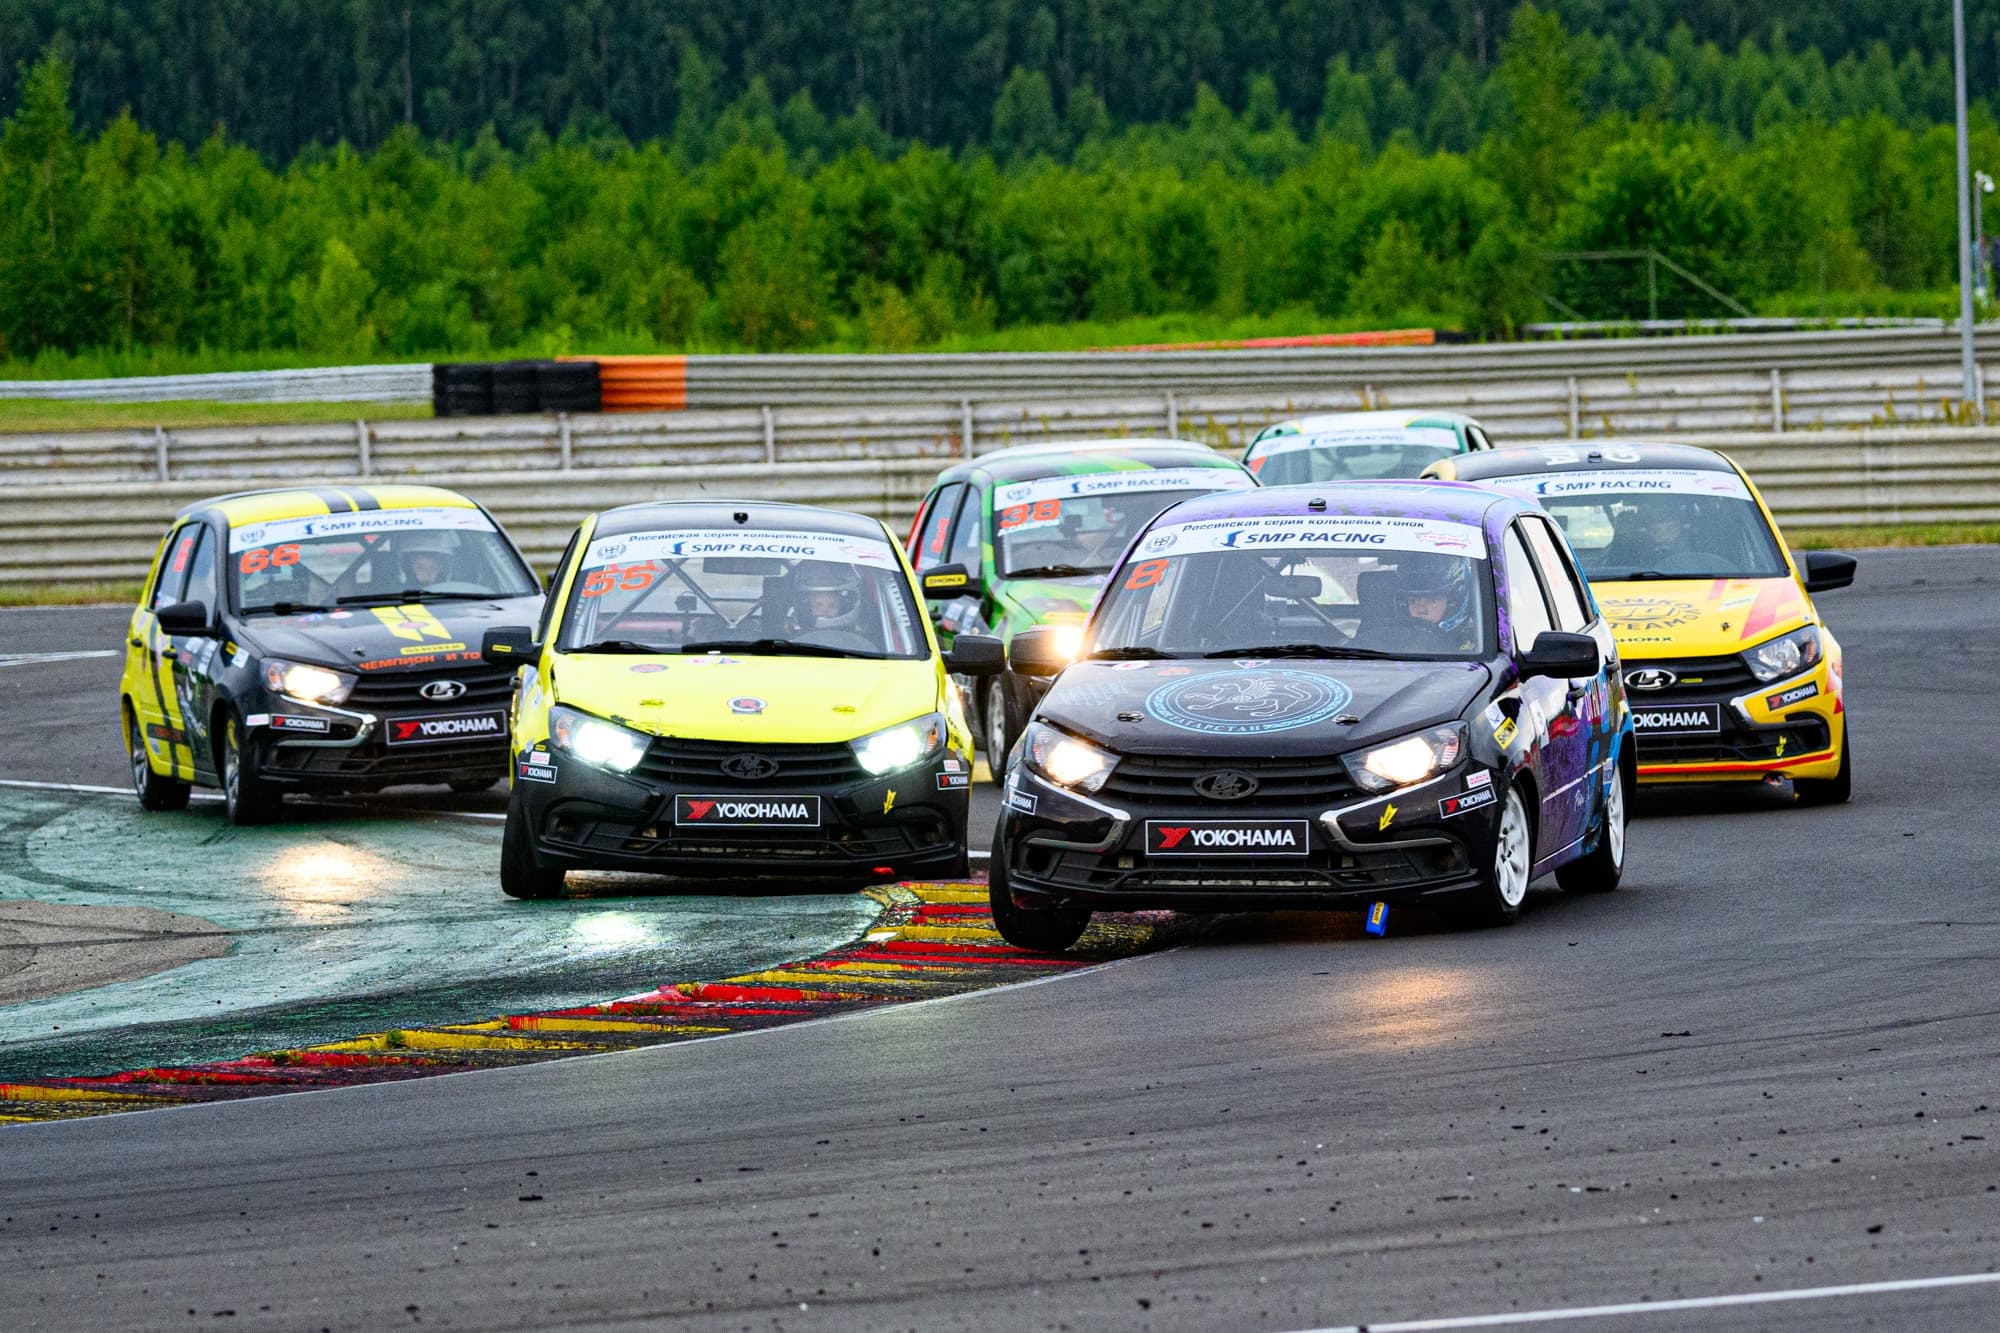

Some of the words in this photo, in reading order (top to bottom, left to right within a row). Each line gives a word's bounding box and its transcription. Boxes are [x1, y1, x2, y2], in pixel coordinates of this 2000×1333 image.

[1087, 480, 1123, 490] SMP
[1127, 478, 1190, 487] RACING
[1555, 482, 1595, 491] SMP
[1600, 481, 1672, 489] RACING
[999, 499, 1062, 529] 38
[320, 522, 356, 531] SMP
[360, 518, 423, 527] RACING
[1182, 520, 1260, 532] Российская
[1264, 519, 1304, 527] серия
[1308, 519, 1382, 527] кольцевых
[629, 532, 699, 542] Российская
[1245, 533, 1295, 543] SMP
[1300, 532, 1387, 544] RACING
[691, 544, 735, 552] SMP
[739, 544, 816, 555] RACING
[239, 543, 301, 575] 66
[581, 565, 656, 598] 55
[1125, 558, 1169, 591] 8
[1608, 618, 1686, 630] TEAM
[358, 655, 435, 671] ЧЕМПИОН
[462, 651, 481, 660] ТО
[1781, 684, 1816, 703] YOKOHAMA
[285, 718, 325, 729] YOKOHAMA
[420, 717, 497, 735] YOKOHAMA
[1632, 711, 1709, 728] OKOHAMA
[1458, 790, 1492, 808] YOKOHAMA
[715, 803, 808, 819] YOKOHAMA
[1190, 829, 1296, 846] YOKOHAMA
